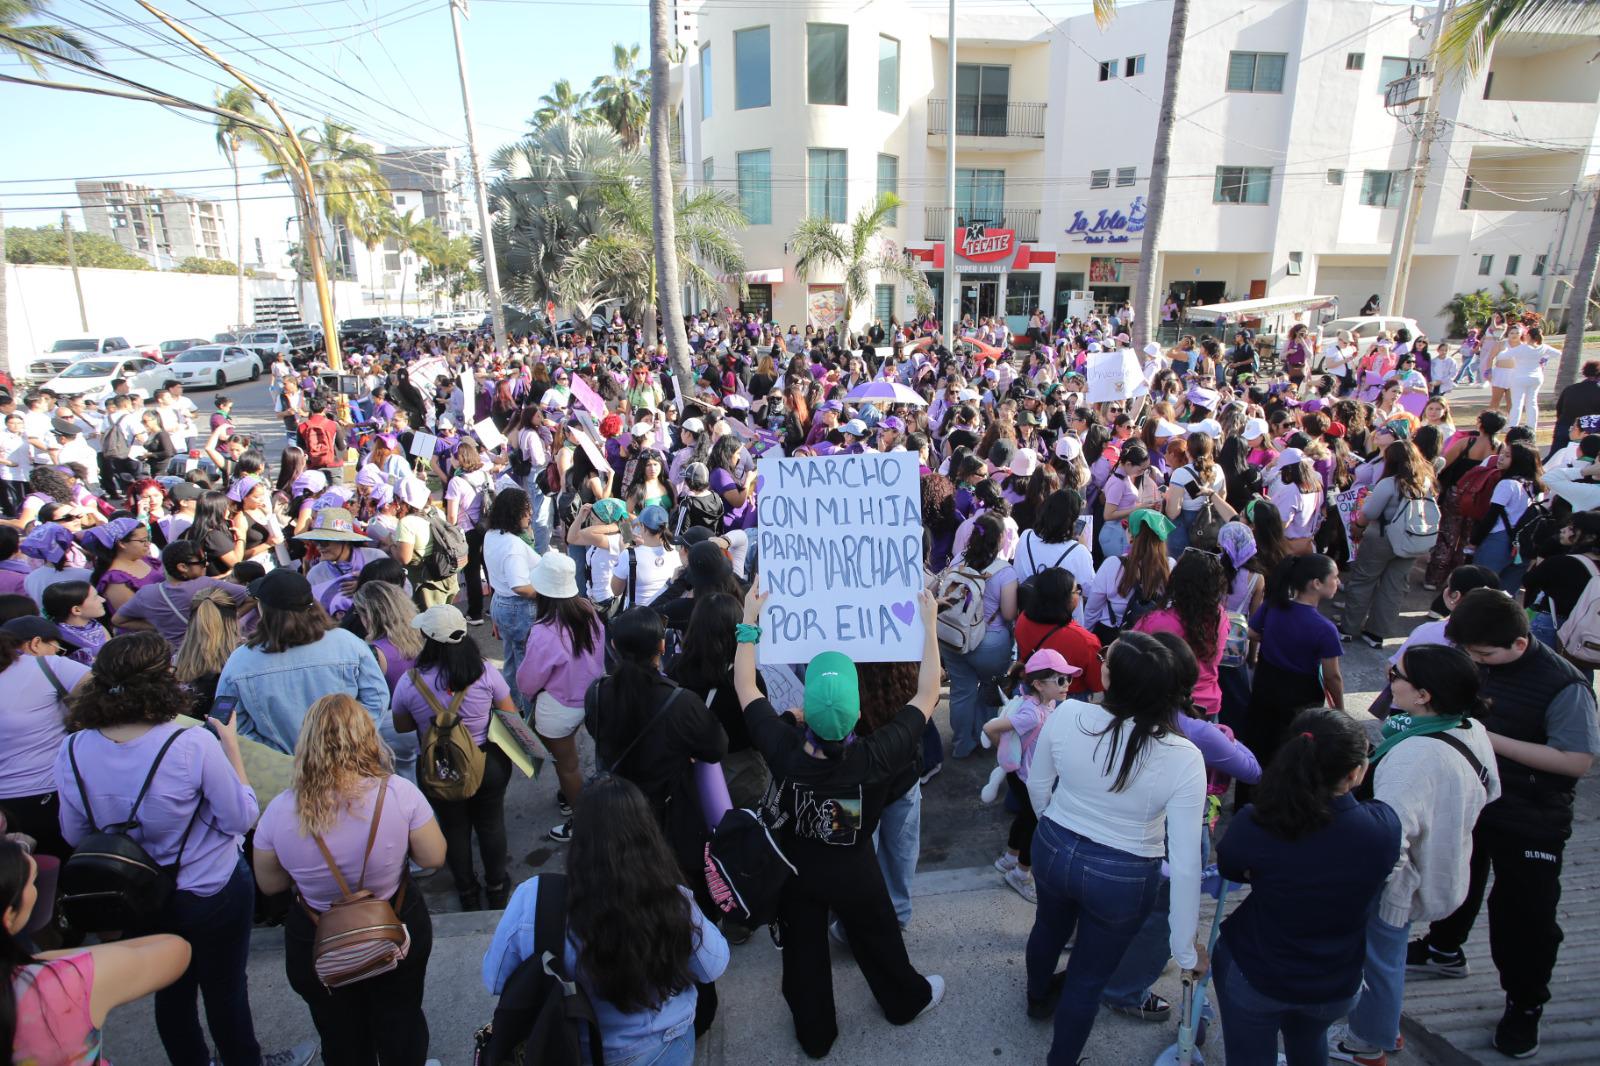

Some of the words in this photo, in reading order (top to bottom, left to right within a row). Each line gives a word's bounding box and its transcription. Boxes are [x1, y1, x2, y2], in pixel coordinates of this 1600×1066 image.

[966, 235, 1009, 253] TECATE
[954, 264, 978, 273] SUPER
[979, 265, 989, 273] LA
[990, 265, 1007, 273] LOLA
[779, 458, 901, 489] MARCHO
[759, 495, 808, 528] CON
[816, 497, 851, 527] MI
[859, 494, 921, 527] HIJA
[1337, 490, 1358, 502] QUE
[761, 531, 808, 561] PARA
[806, 534, 923, 591] MARCHAR
[767, 566, 806, 597] NO
[768, 604, 827, 645] POR
[1524, 850, 1540, 859] OLD
[1540, 851, 1557, 862] NAVY
